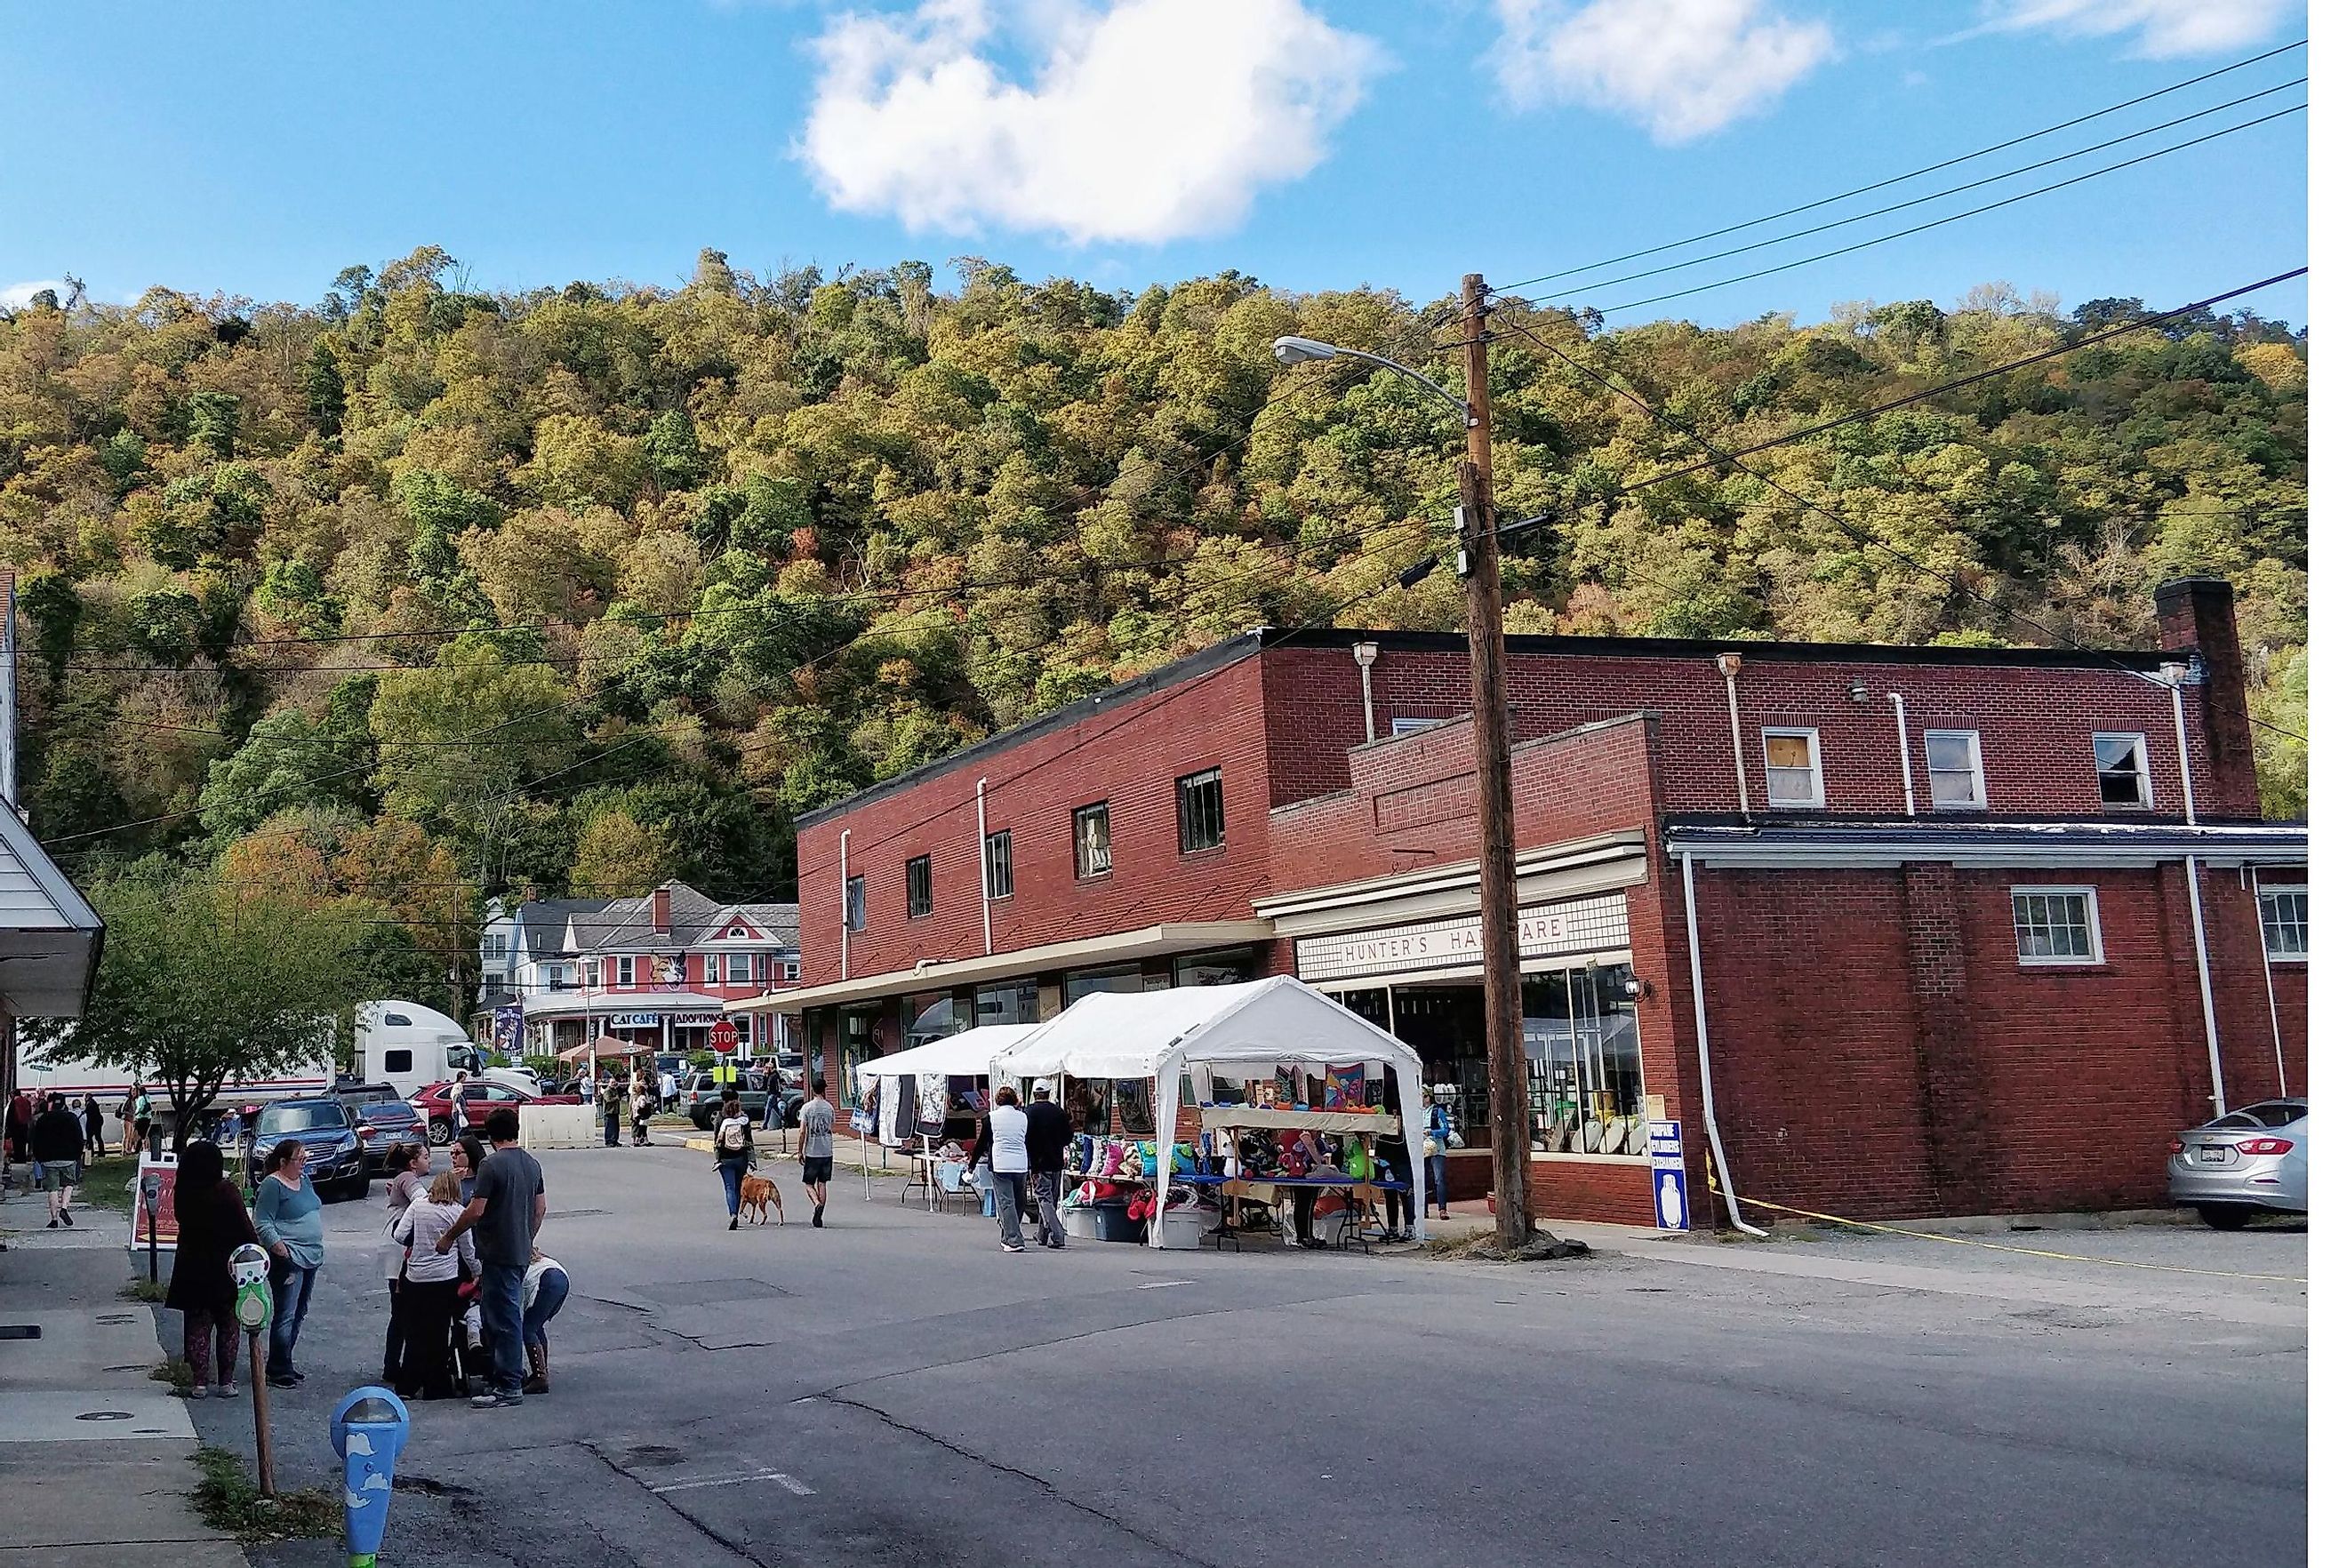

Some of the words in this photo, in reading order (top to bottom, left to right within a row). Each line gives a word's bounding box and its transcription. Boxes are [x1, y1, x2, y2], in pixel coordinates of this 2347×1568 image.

[1345, 937, 1427, 961] HUNTER'S
[1450, 918, 1560, 949] HAARE
[611, 1013, 632, 1025] CAT
[632, 1012, 658, 1024] CAFÉ
[711, 1031, 738, 1043] STOP
